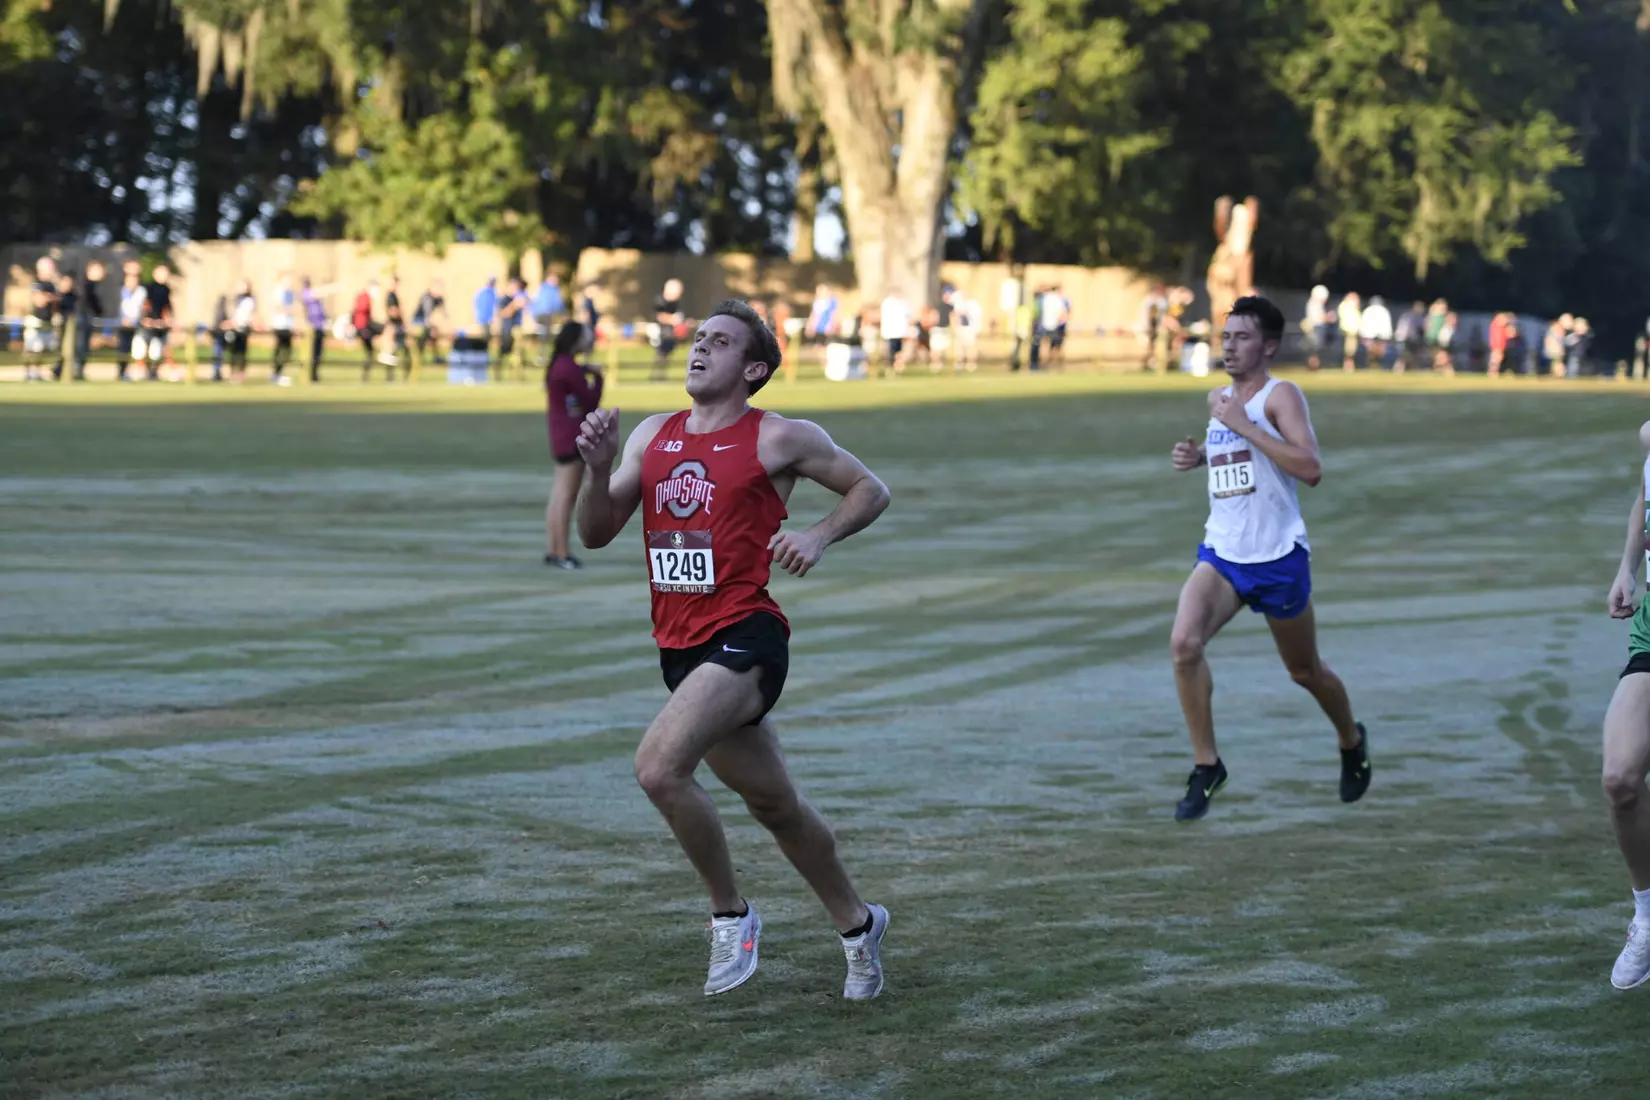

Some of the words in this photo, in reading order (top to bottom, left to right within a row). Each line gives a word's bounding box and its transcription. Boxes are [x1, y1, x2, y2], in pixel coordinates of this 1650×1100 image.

[1214, 465, 1249, 489] 1115
[655, 551, 707, 582] 1249
[672, 584, 682, 592] XC
[682, 585, 709, 593] INVITE
